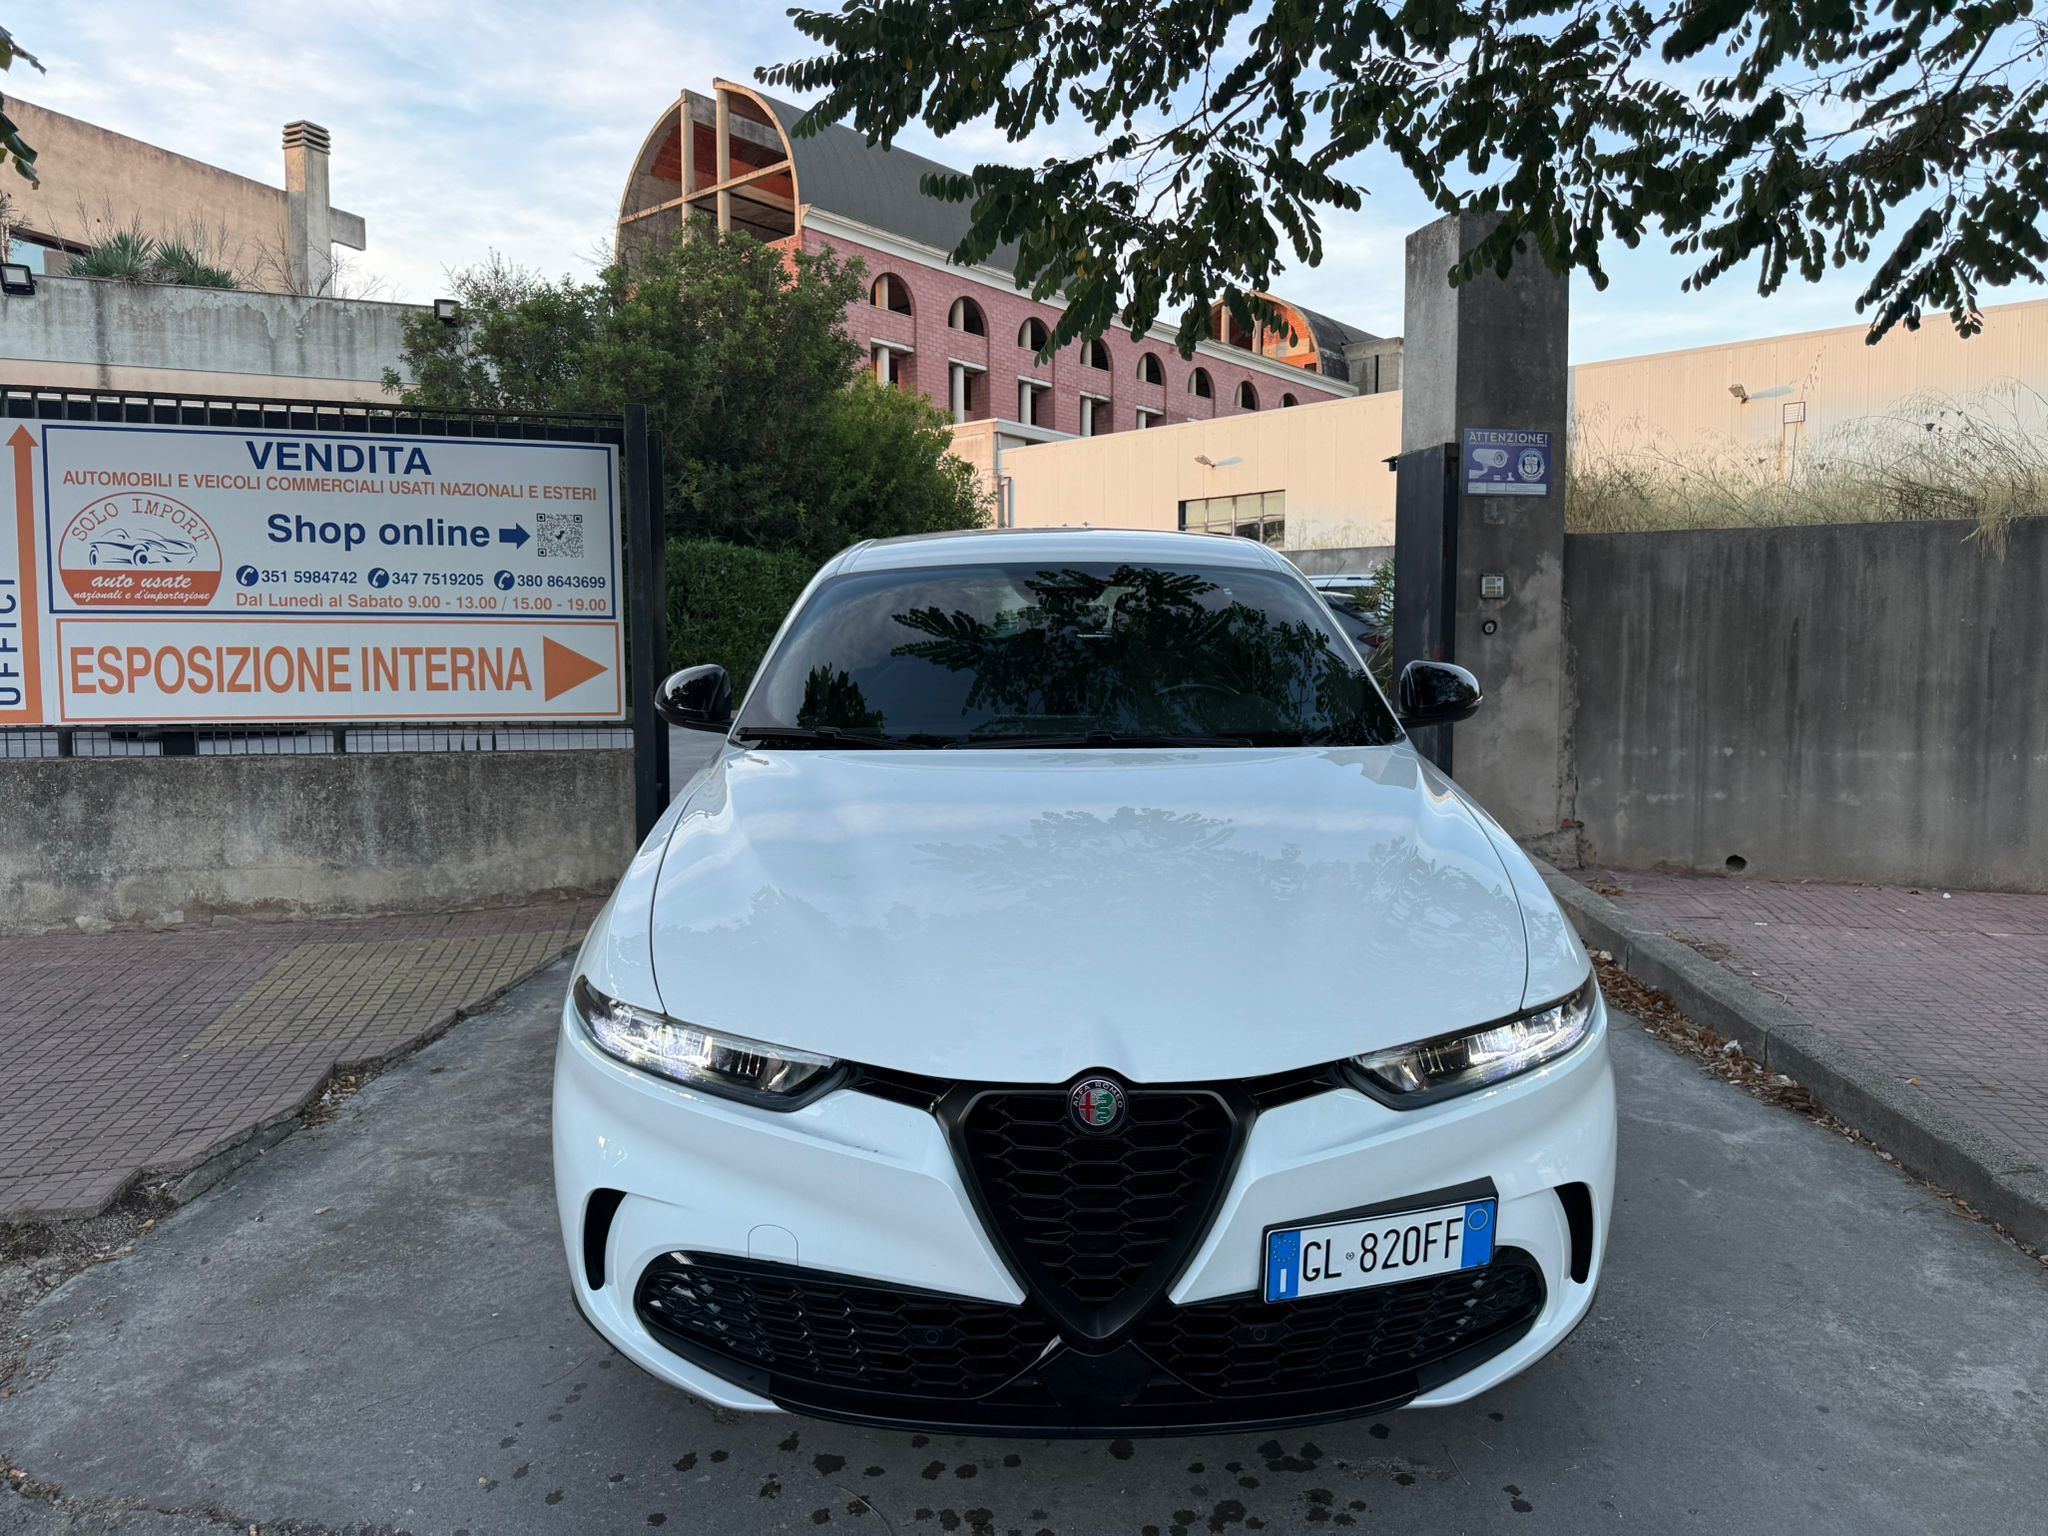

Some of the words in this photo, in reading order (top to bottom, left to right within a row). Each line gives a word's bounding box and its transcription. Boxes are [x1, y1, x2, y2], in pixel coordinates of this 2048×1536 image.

[1469, 431, 1548, 444] ATTENZIONE!
[246, 440, 432, 476] VENDITA
[62, 470, 173, 488] AUTOMOBILI
[178, 473, 189, 488] E
[194, 474, 261, 491] VEICOLI
[265, 476, 384, 495] COMMERCIALI
[389, 480, 436, 496] USATI
[439, 482, 524, 499] NAZIONALI
[528, 485, 539, 499] E
[543, 485, 597, 501] ESTERI
[71, 501, 119, 542] SOLO
[131, 497, 210, 543] IMPORT
[267, 513, 366, 552] Shop
[378, 518, 491, 548] online
[91, 573, 136, 588] auto
[140, 574, 193, 588] usate
[261, 570, 288, 583] 351
[293, 571, 358, 584] 5984742
[391, 572, 419, 585] 347
[423, 573, 484, 587] 7519205
[517, 574, 543, 588] 380
[547, 575, 606, 589] 8643699
[73, 589, 123, 603] nazionali
[125, 592, 132, 600] e
[134, 588, 211, 603] d'importazione
[236, 592, 263, 607] Dal
[268, 593, 324, 608] Lunedì
[328, 594, 343, 608] al
[349, 594, 404, 609] Sabato
[408, 595, 441, 610] 9.00
[456, 596, 498, 611] 13.00
[501, 595, 508, 612] /
[511, 596, 553, 612] 15.00
[567, 598, 607, 612] 19.00
[70, 646, 352, 694] ESPOSIZIONE
[361, 646, 532, 693] INTERNA
[1073, 1085, 1091, 1107] ALFA
[1095, 1081, 1124, 1108] ROMEO
[1302, 1238, 1342, 1282] GL
[1359, 1216, 1464, 1273] 820FF
